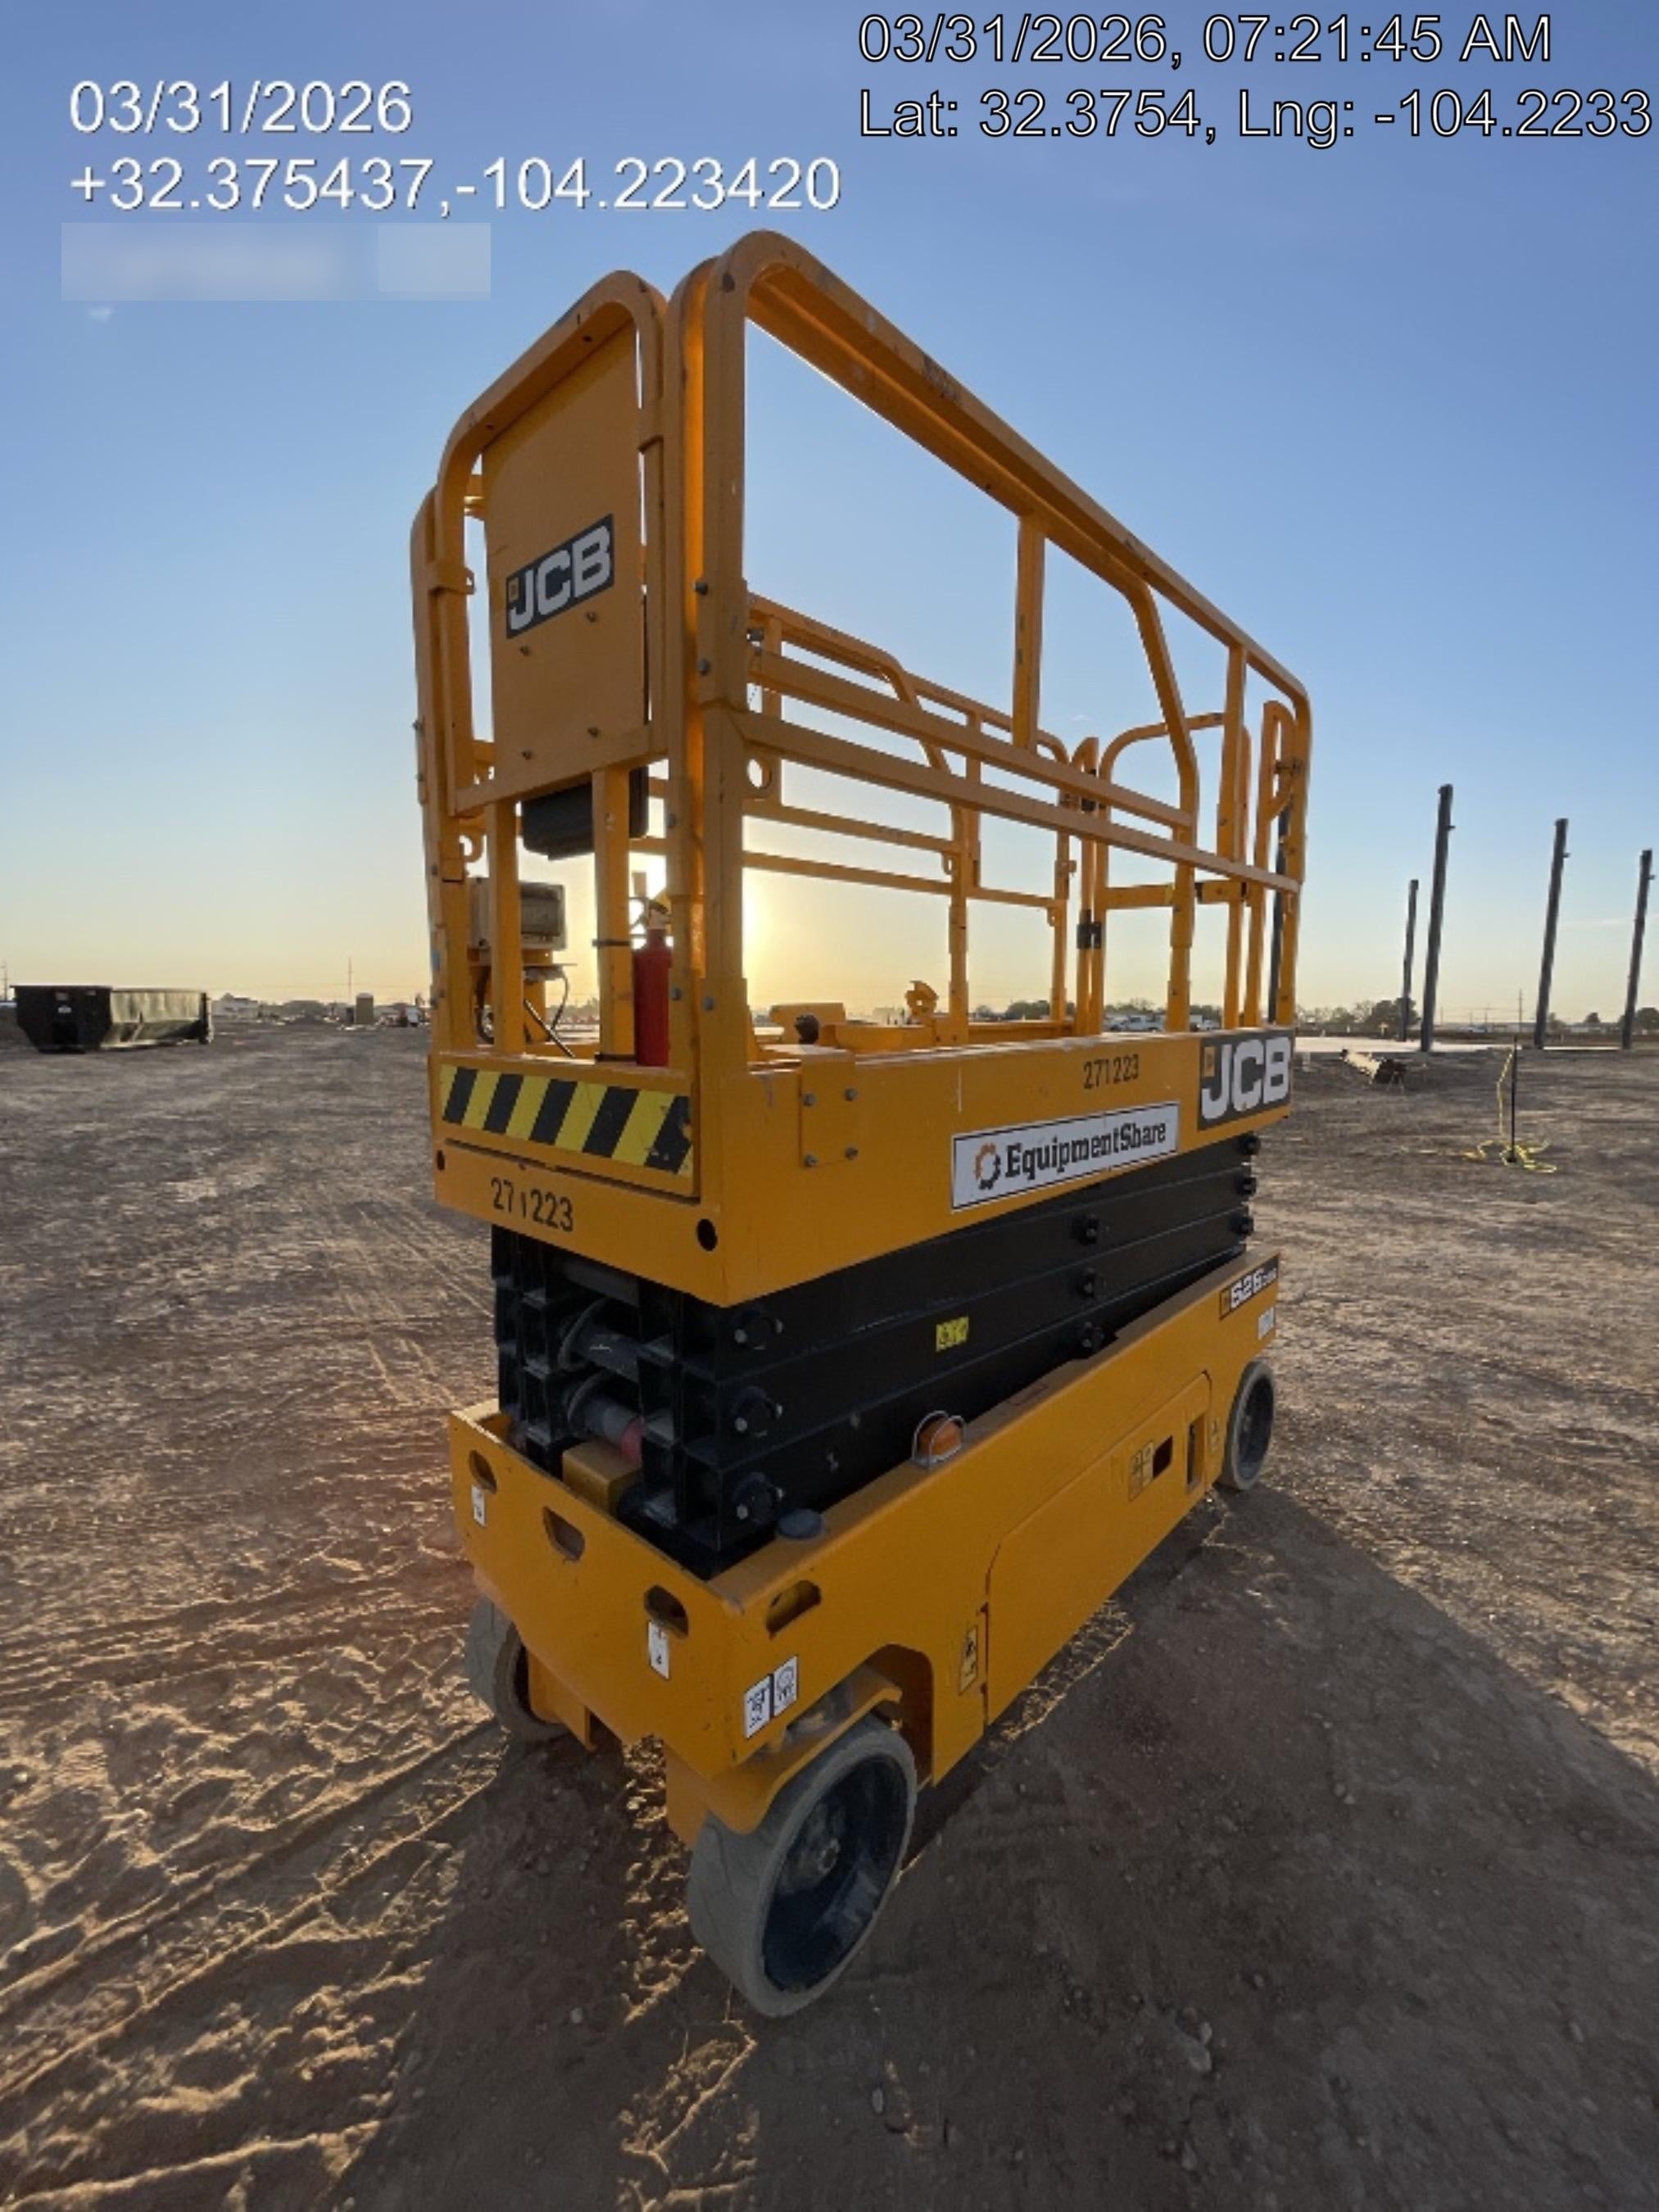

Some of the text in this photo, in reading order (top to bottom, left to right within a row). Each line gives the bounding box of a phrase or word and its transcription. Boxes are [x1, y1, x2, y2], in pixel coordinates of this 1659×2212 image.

[510, 525, 611, 630] JCB
[1083, 1054, 1139, 1090] 271223
[1201, 1036, 1291, 1119] JCB
[1005, 1122, 1167, 1180] EquipmentShare
[491, 1176, 573, 1232] 271223
